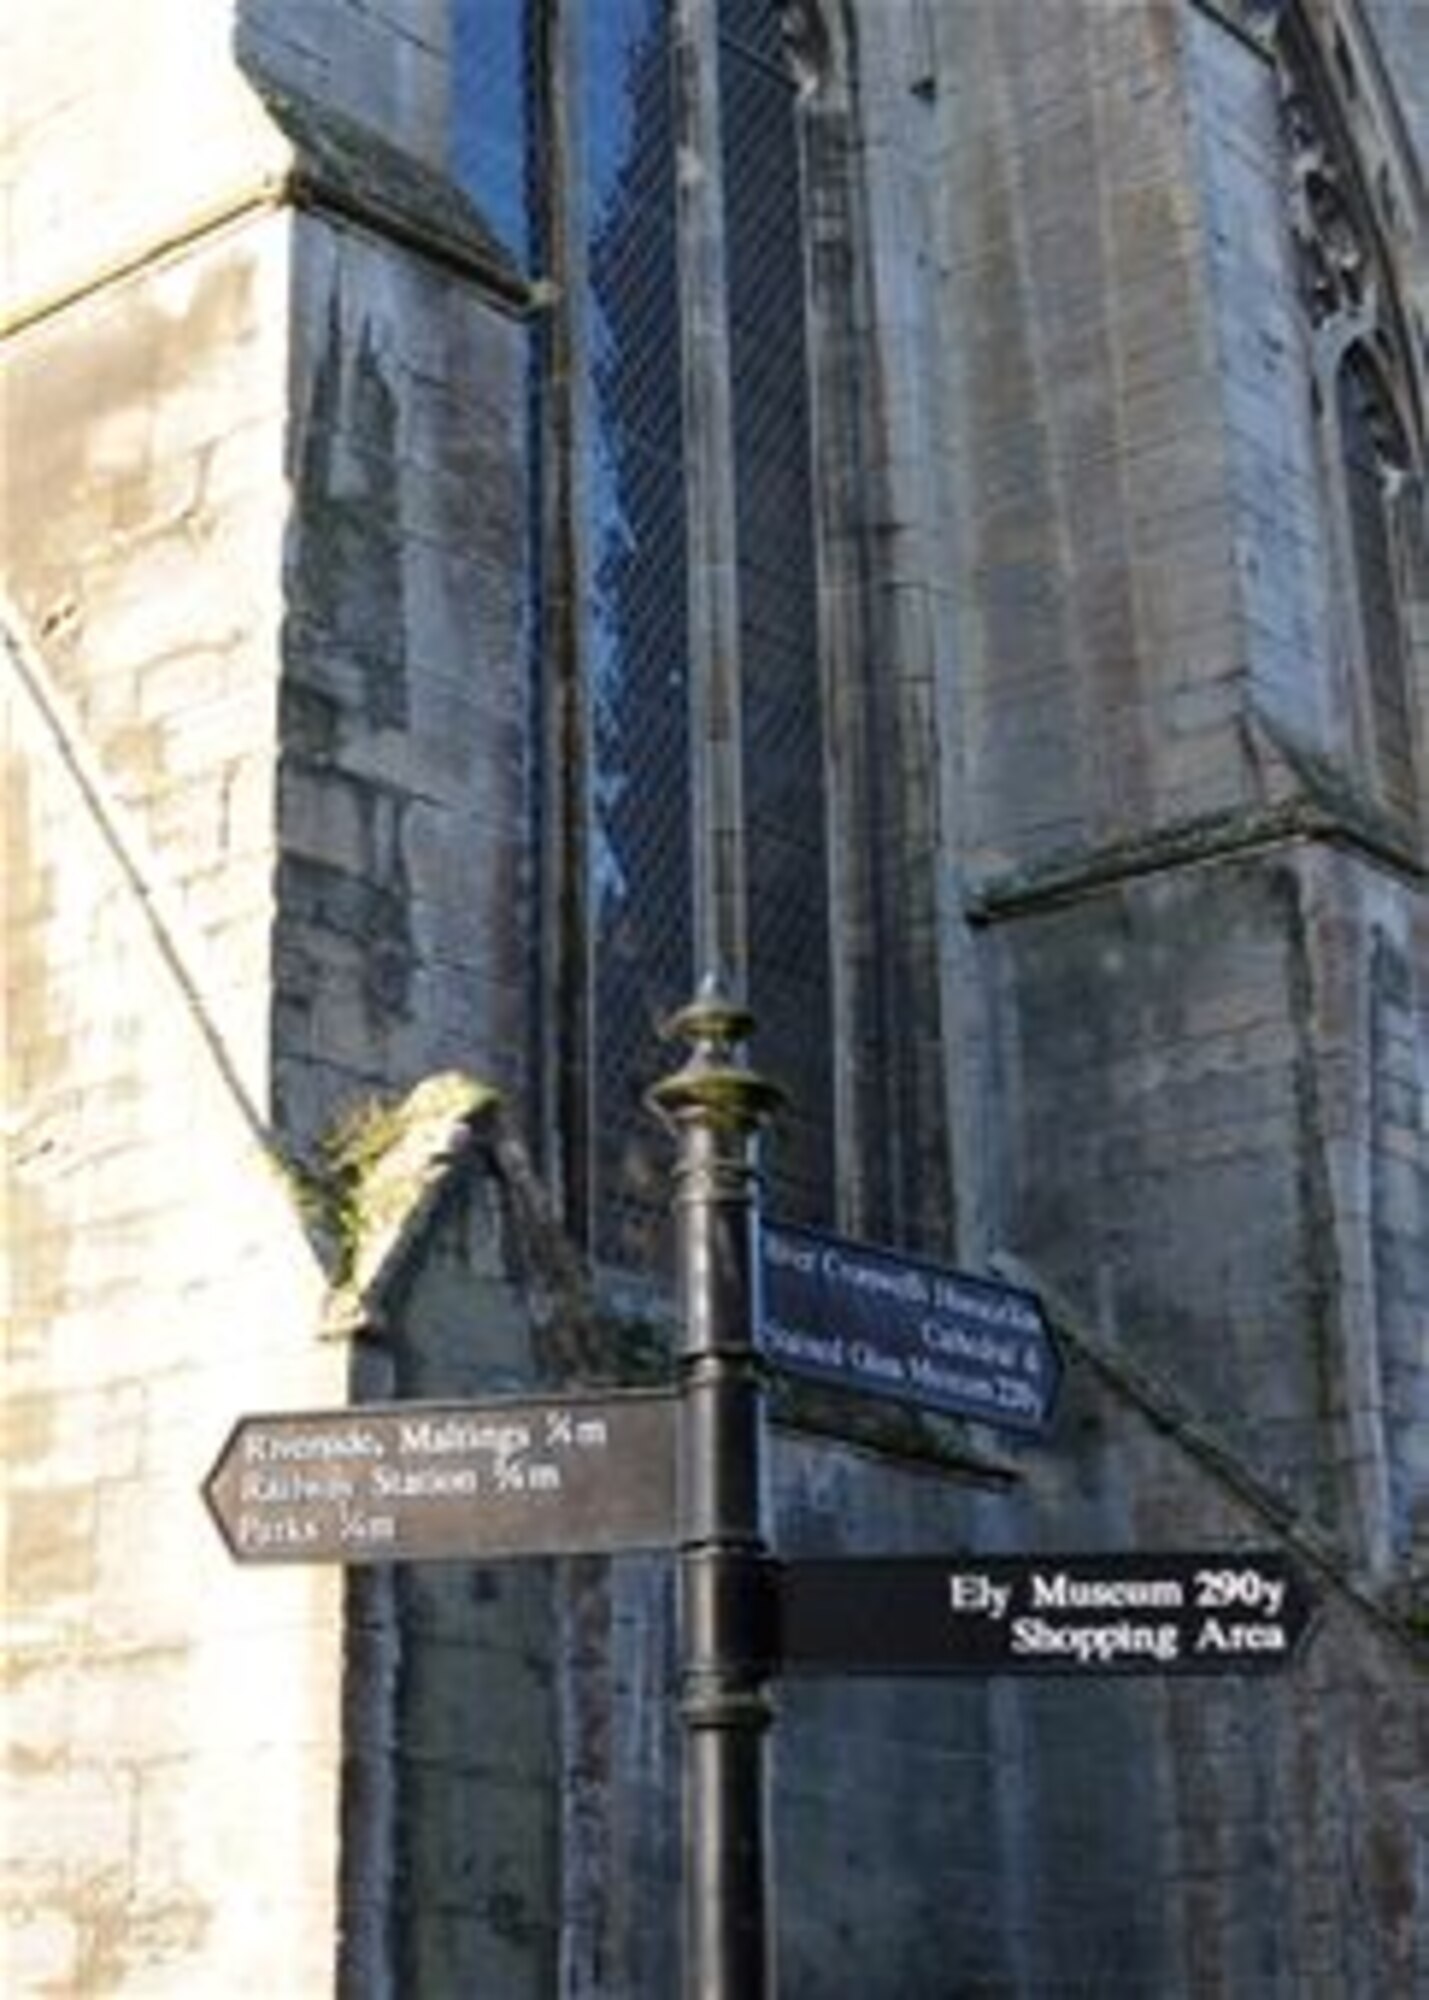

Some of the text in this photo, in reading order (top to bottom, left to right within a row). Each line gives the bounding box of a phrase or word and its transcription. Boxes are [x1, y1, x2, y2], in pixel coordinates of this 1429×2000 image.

[400, 1419, 529, 1459] Maltings
[375, 1463, 479, 1497] Station
[238, 1512, 319, 1547] Parks
[950, 1571, 1286, 1620] Ely Museum 290y
[1011, 1617, 1286, 1660] Shopping Area
